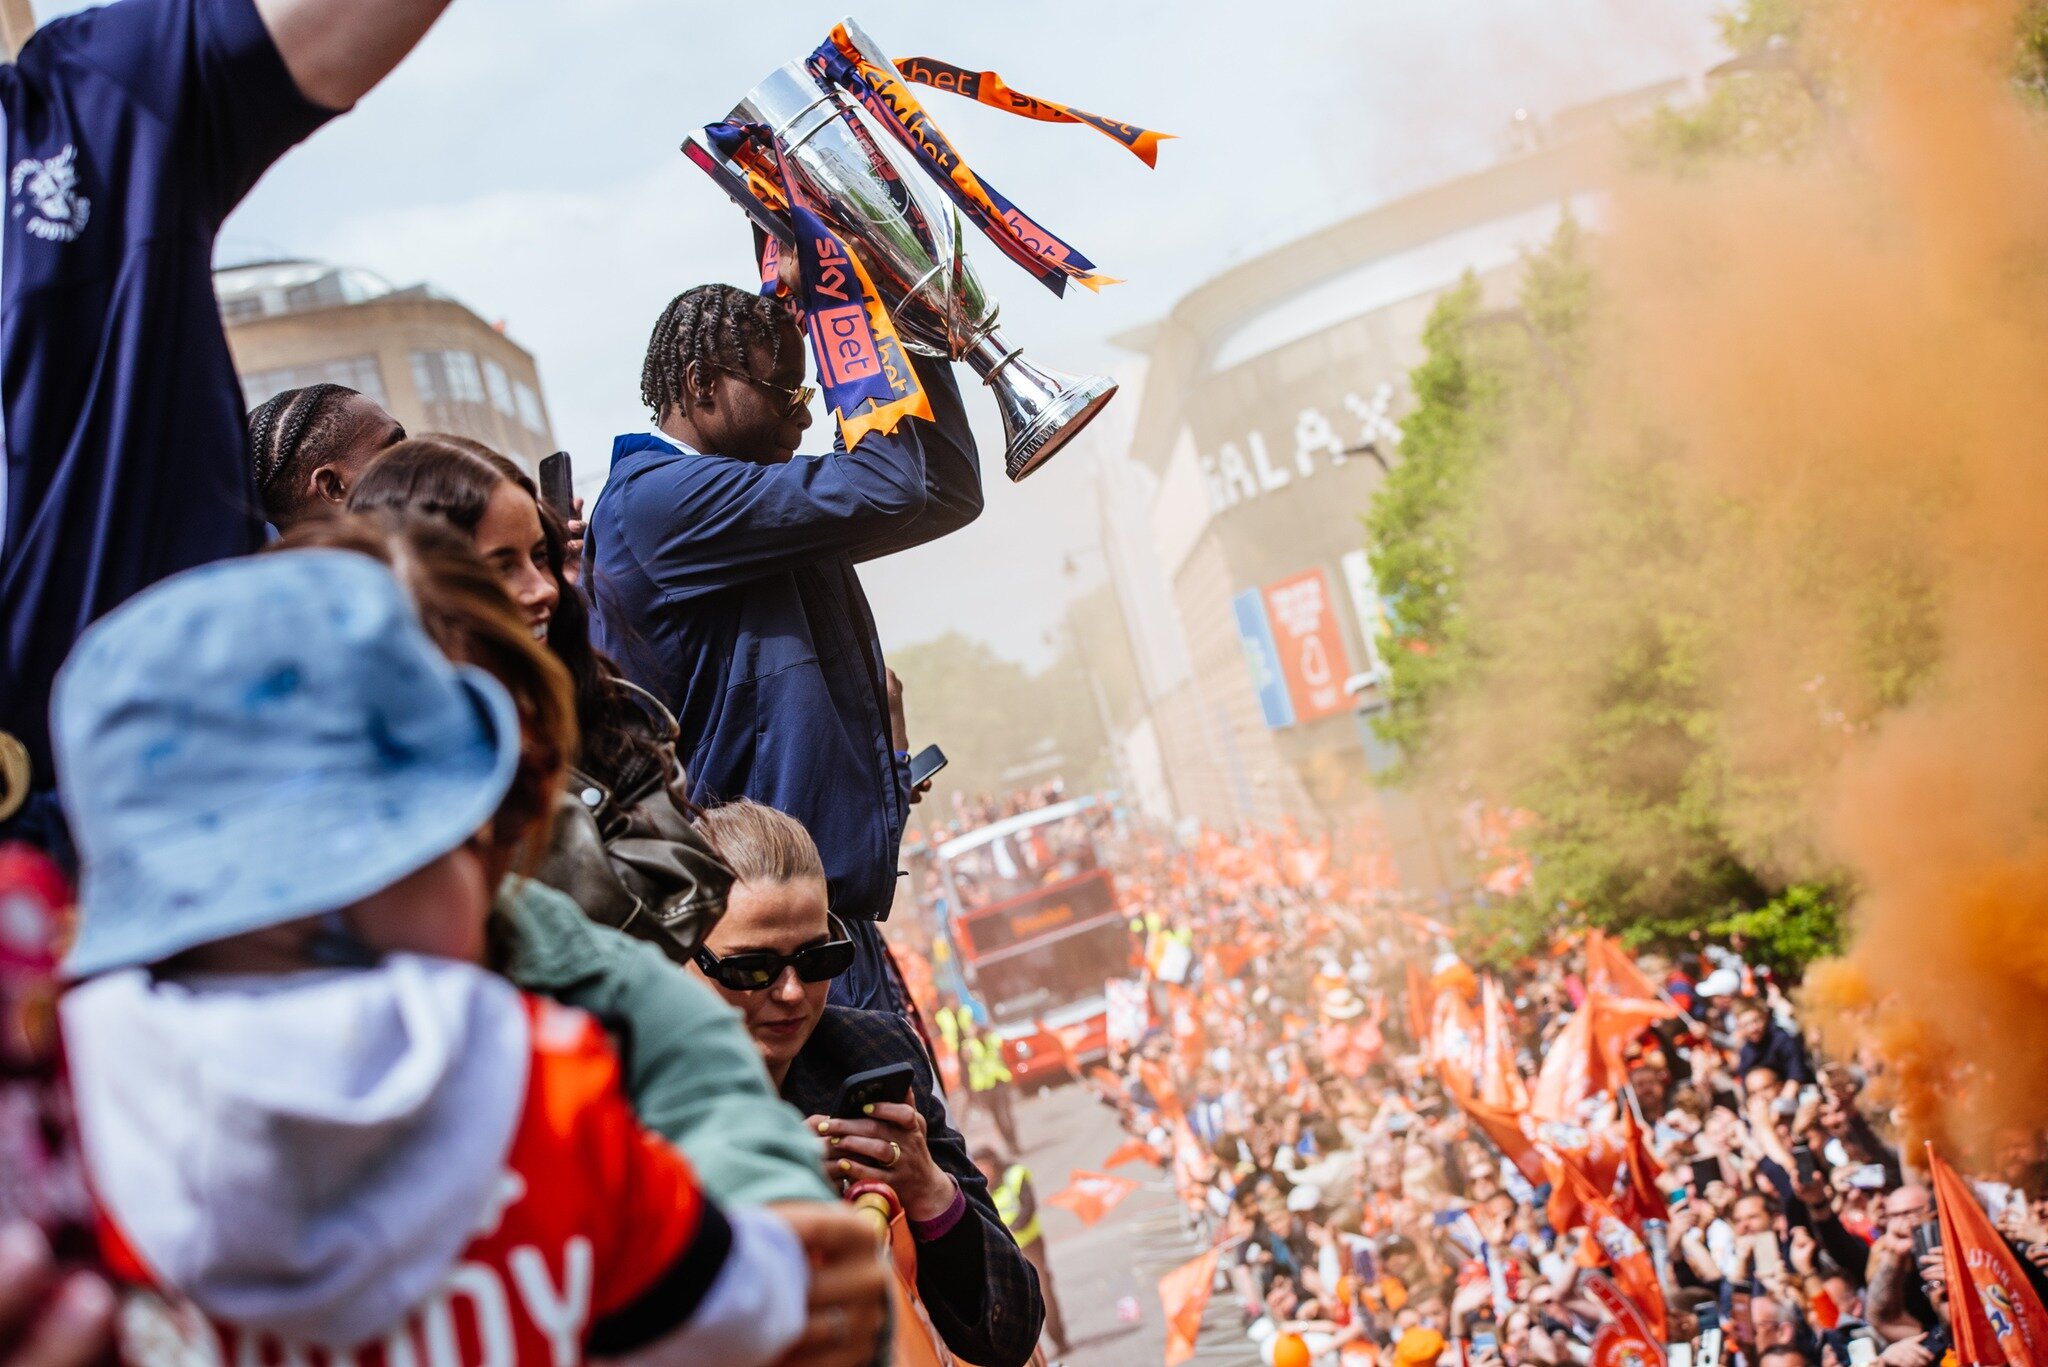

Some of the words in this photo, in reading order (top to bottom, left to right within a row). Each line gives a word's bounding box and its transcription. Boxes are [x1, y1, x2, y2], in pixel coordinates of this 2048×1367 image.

[911, 60, 973, 96] bet
[763, 239, 779, 276] et
[815, 237, 849, 302] sky
[831, 313, 870, 375] bet
